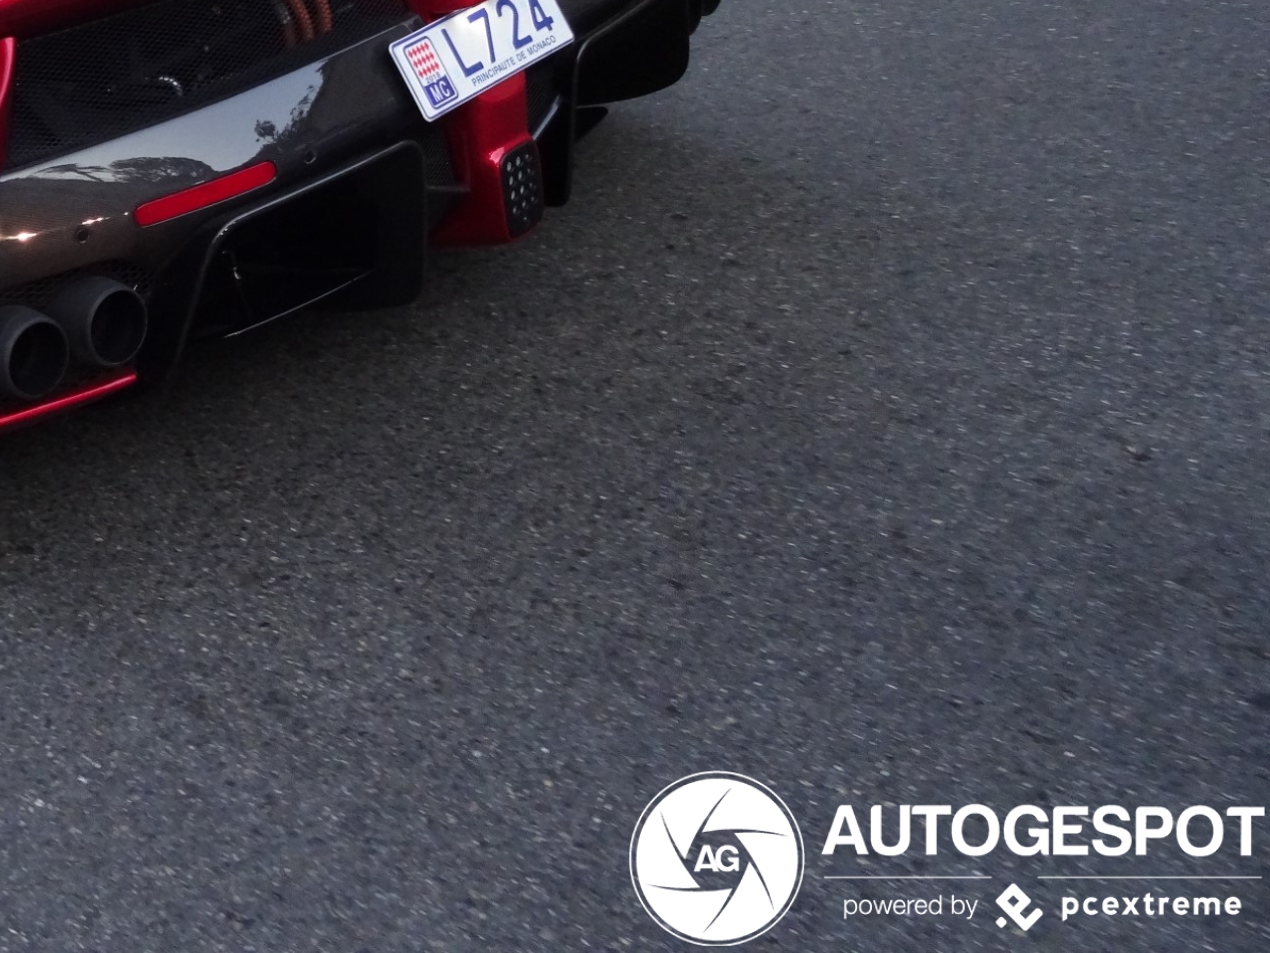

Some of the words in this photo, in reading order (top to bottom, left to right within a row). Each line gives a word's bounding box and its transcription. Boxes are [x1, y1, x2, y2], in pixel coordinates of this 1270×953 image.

[471, 57, 516, 87] PRINCIPAUTE
[516, 49, 527, 62] DE
[526, 35, 556, 54] MONACO
[430, 80, 450, 103] MC
